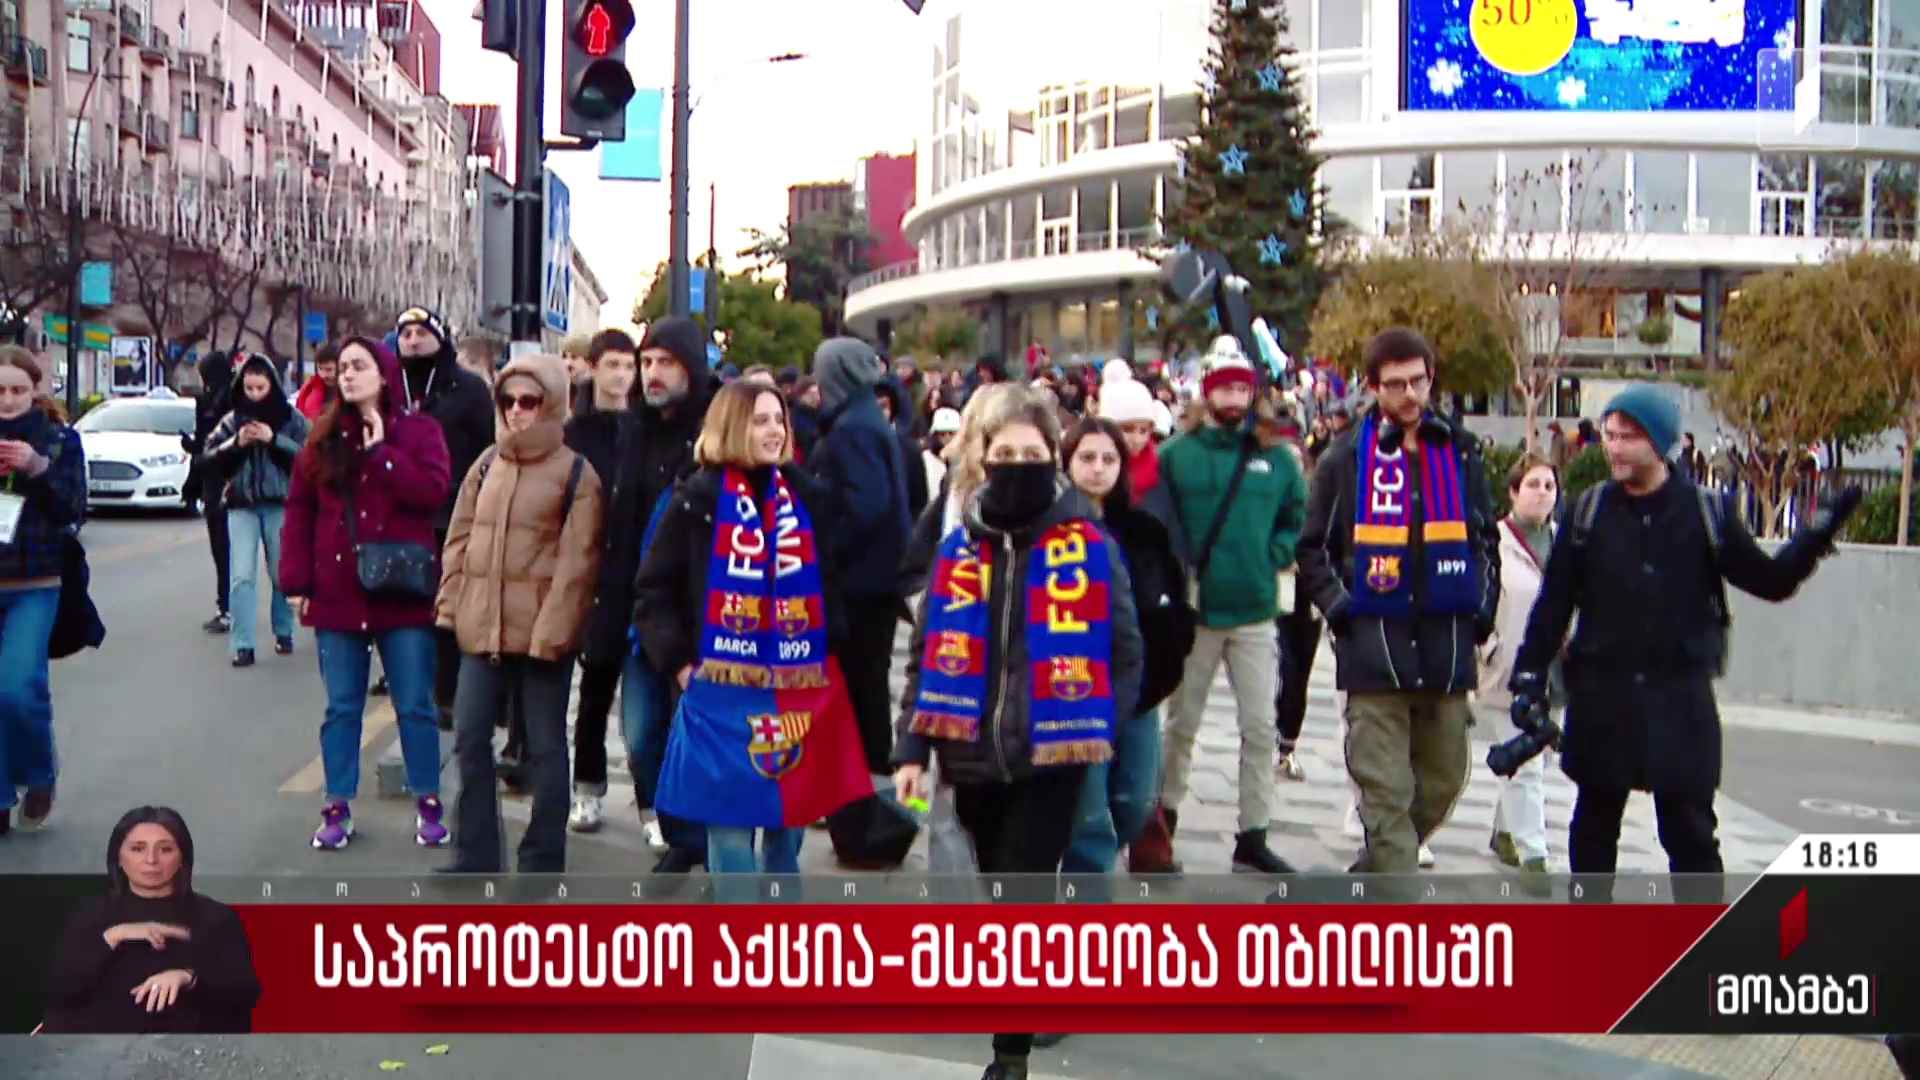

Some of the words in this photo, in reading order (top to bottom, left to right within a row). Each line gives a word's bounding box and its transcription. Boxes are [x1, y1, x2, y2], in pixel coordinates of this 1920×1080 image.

[1371, 467, 1405, 514] FC
[1046, 522, 1089, 634] FCB
[778, 640, 811, 660] 1899
